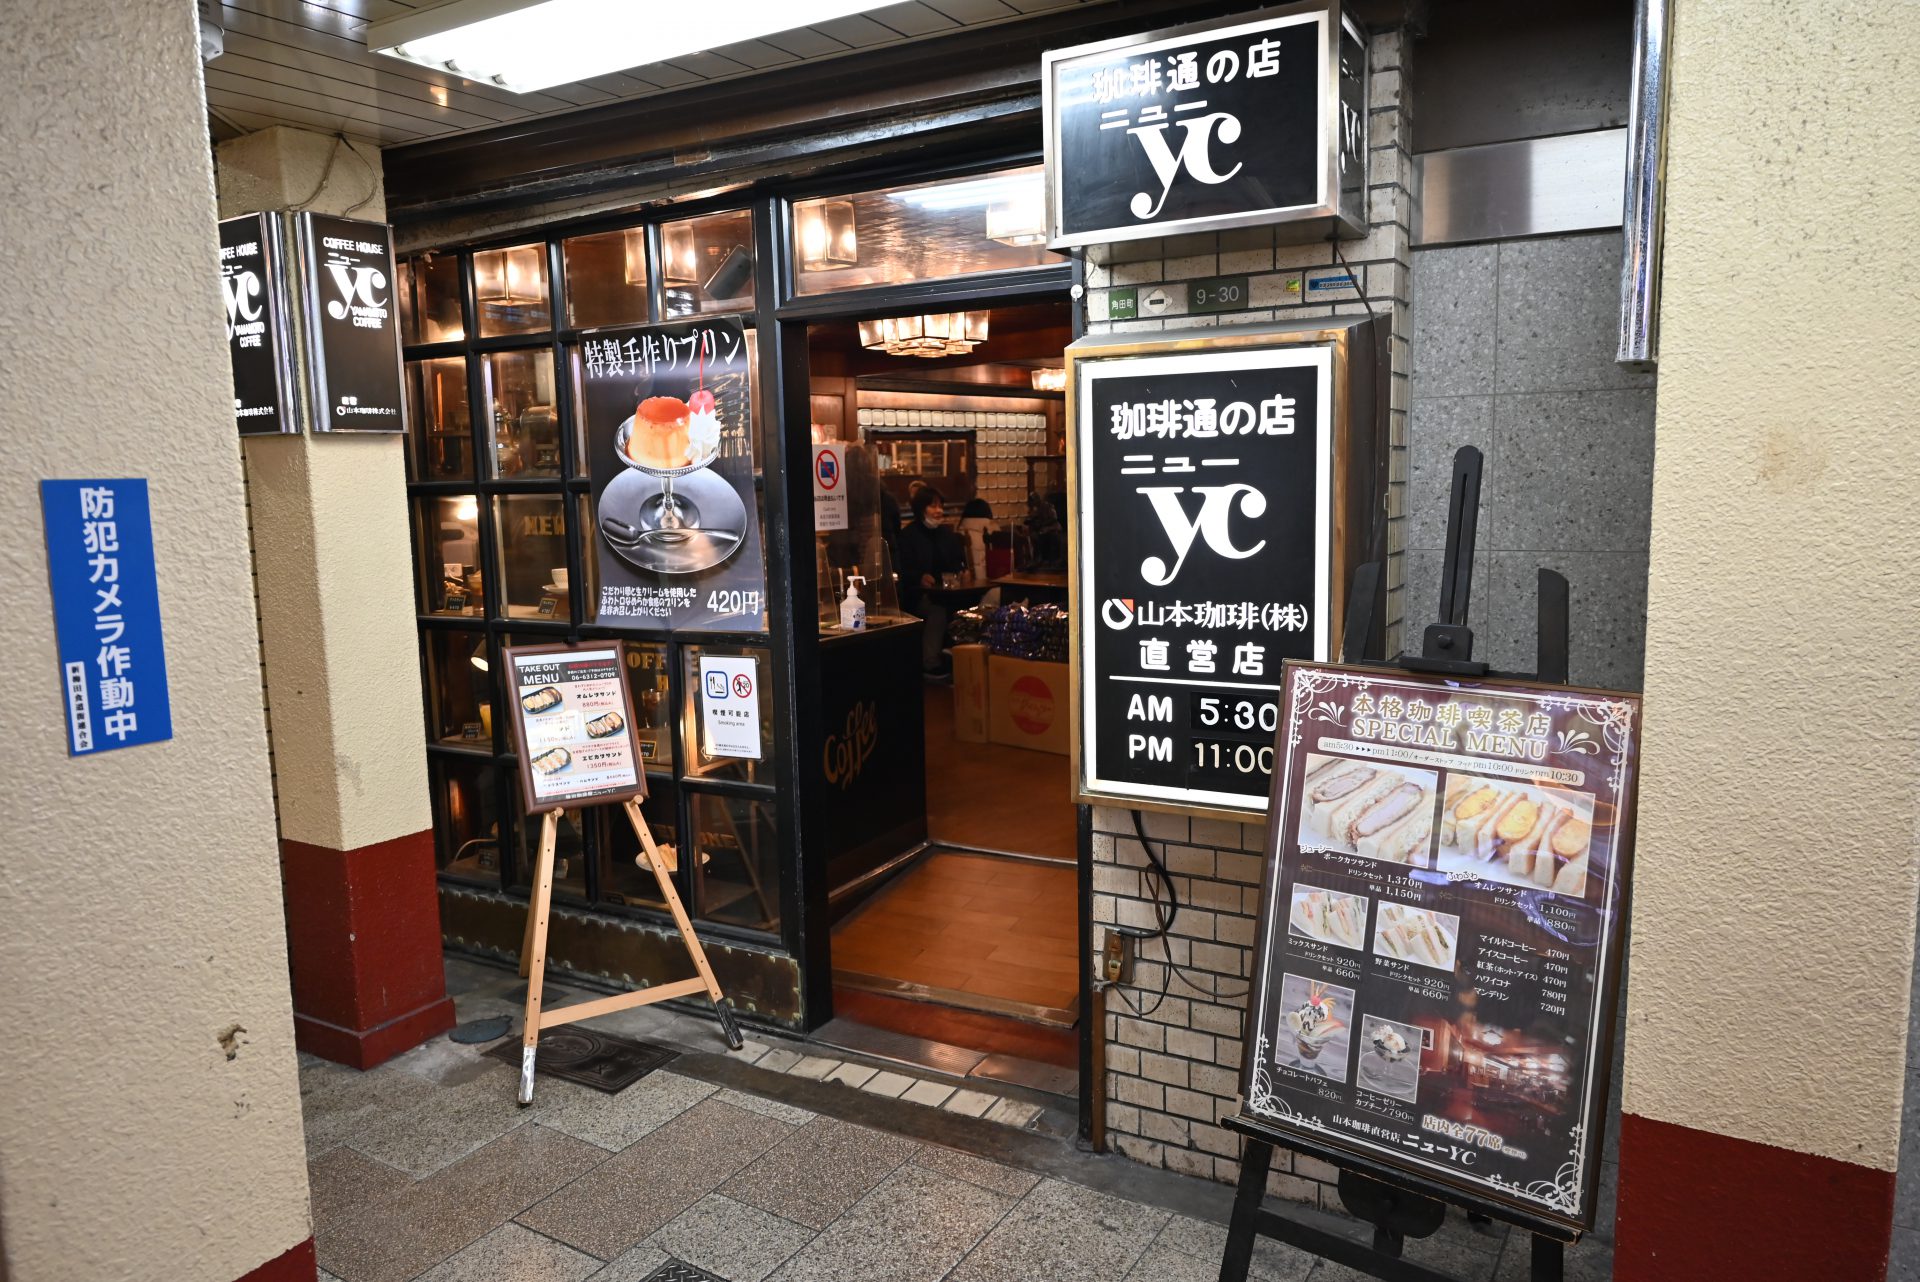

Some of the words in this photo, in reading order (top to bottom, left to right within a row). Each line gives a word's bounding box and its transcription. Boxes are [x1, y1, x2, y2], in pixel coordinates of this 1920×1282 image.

[1093, 38, 1281, 103] 珈琲通の店
[1100, 100, 1207, 130] ニュー
[236, 242, 258, 257] HOUSE
[323, 237, 355, 251] COFFEE
[356, 241, 384, 255] HOUSE
[328, 252, 360, 264] ニュー
[1112, 299, 1133, 310] 角田町
[1197, 286, 1239, 304] 9-30
[353, 317, 382, 329] COFFEE
[584, 328, 741, 379] 特製手作りプリン
[1110, 394, 1296, 440] 珈琲通の店
[1121, 455, 1240, 474] ニュー
[707, 590, 759, 616] 420円
[80, 487, 137, 741] 防犯カメラ作動中
[1138, 600, 1308, 632] 山本珈琲(株)
[1139, 640, 1266, 676] 直営店
[520, 665, 541, 674] TAKE
[523, 673, 560, 685] MENU
[1127, 694, 1173, 723] AM
[1200, 698, 1278, 732] 5:30
[1352, 693, 1551, 737] 本格珈琲喫茶店
[1323, 740, 1354, 751] am5:30
[1353, 719, 1456, 748] SPECIAL
[1467, 732, 1547, 760] MENU
[1129, 734, 1173, 763] PM
[1194, 743, 1274, 774] 11:00
[1300, 845, 1333, 854] ジューシー
[1323, 853, 1378, 868] ポークカツサンド
[1348, 868, 1383, 881] ドリンクセット
[1446, 871, 1478, 881] ふわふわ
[1369, 884, 1382, 892] 単品
[1386, 886, 1421, 901] 1,150円
[1474, 882, 1528, 897] オムレツサンド
[1494, 897, 1534, 910] ドリンクセット
[1547, 918, 1576, 932] 880円
[1288, 938, 1328, 952] ミックスサンド
[1480, 934, 1537, 952] マイルドコーヒー
[1545, 949, 1570, 961] 470円
[1304, 951, 1335, 963] ドリンクセット
[1336, 957, 1361, 969] 920円
[1375, 958, 1410, 971] 野菜サンド
[1478, 947, 1528, 964] アイスコーヒー
[1544, 962, 1568, 974] 470円
[1335, 968, 1360, 980] 660円
[1389, 971, 1421, 983] ドリンクセット
[1424, 977, 1450, 990] 920円
[1543, 976, 1567, 988] 470円
[1422, 988, 1449, 1001] 660円
[1475, 974, 1511, 988] ハワイコナ
[1541, 989, 1567, 1002] 780円
[1474, 987, 1509, 1001] マンデリン
[1540, 1002, 1565, 1016] 720円
[1276, 1066, 1328, 1087] チョコレートパフェ
[1318, 1088, 1342, 1101] 820円
[1356, 1091, 1402, 1107] コーヒーゼリー
[1389, 1108, 1414, 1121] 790円
[1333, 1114, 1401, 1143] 山本珈琲直営店
[1402, 1133, 1476, 1165] ニューYC
[1422, 1113, 1502, 1150] 店内全77席
